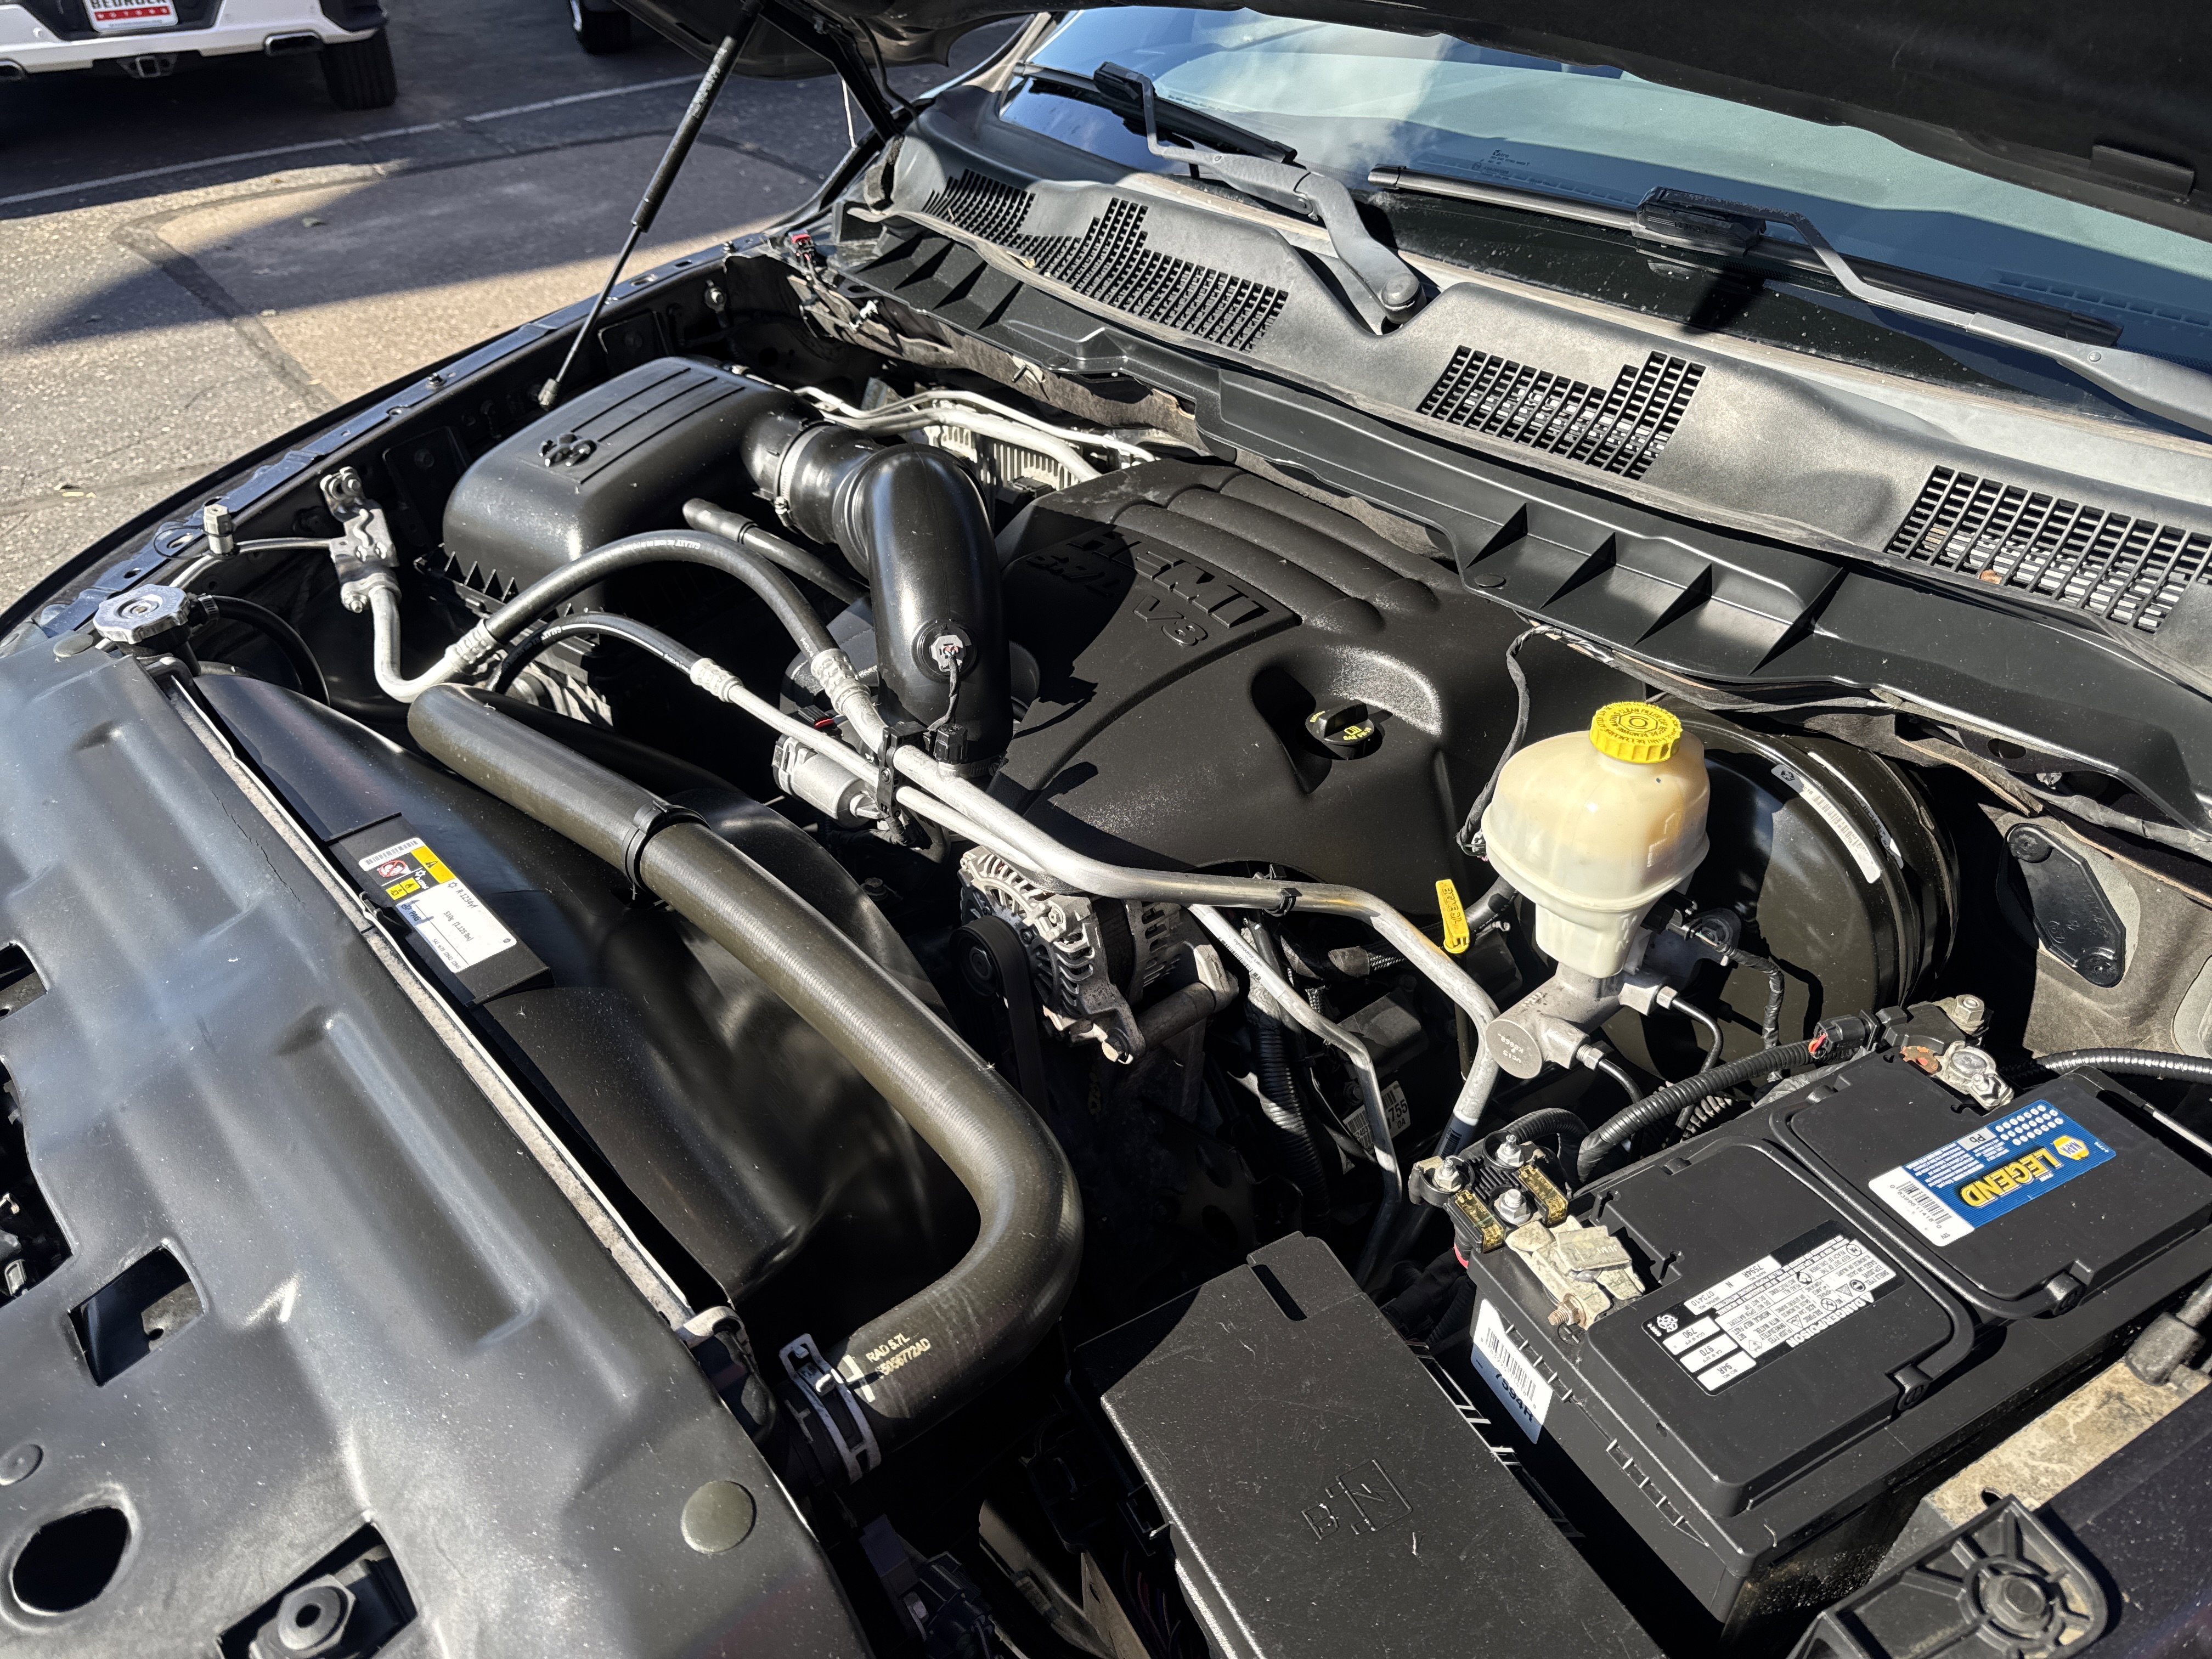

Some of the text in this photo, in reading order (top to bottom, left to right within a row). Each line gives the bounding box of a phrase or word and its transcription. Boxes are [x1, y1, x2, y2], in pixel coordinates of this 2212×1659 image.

[675, 539, 701, 550] GALAXY
[1066, 530, 1270, 629] HEMI
[1132, 594, 1209, 647] V8
[455, 888, 479, 910] R-1234yf
[1441, 887, 1459, 912] ENGINE
[409, 911, 421, 922] PAG
[443, 911, 455, 922] 510g
[1967, 1133, 1987, 1145] Pb
[2061, 1141, 2083, 1155] NAPA
[1960, 1147, 2063, 1207] LEGEND
[1939, 1232, 1951, 1240] 12V
[1740, 1263, 1764, 1278] 7594R
[1724, 1280, 1735, 1289] N
[1689, 1290, 1716, 1307] 073410
[1784, 1297, 1867, 1348] DANGER/POISON
[1680, 1327, 1698, 1339] 790
[865, 1333, 911, 1363] RAD 5.7L
[1697, 1344, 1716, 1357] 970
[1715, 1362, 1733, 1375] 94R
[1495, 1373, 1533, 1423] 7594R
